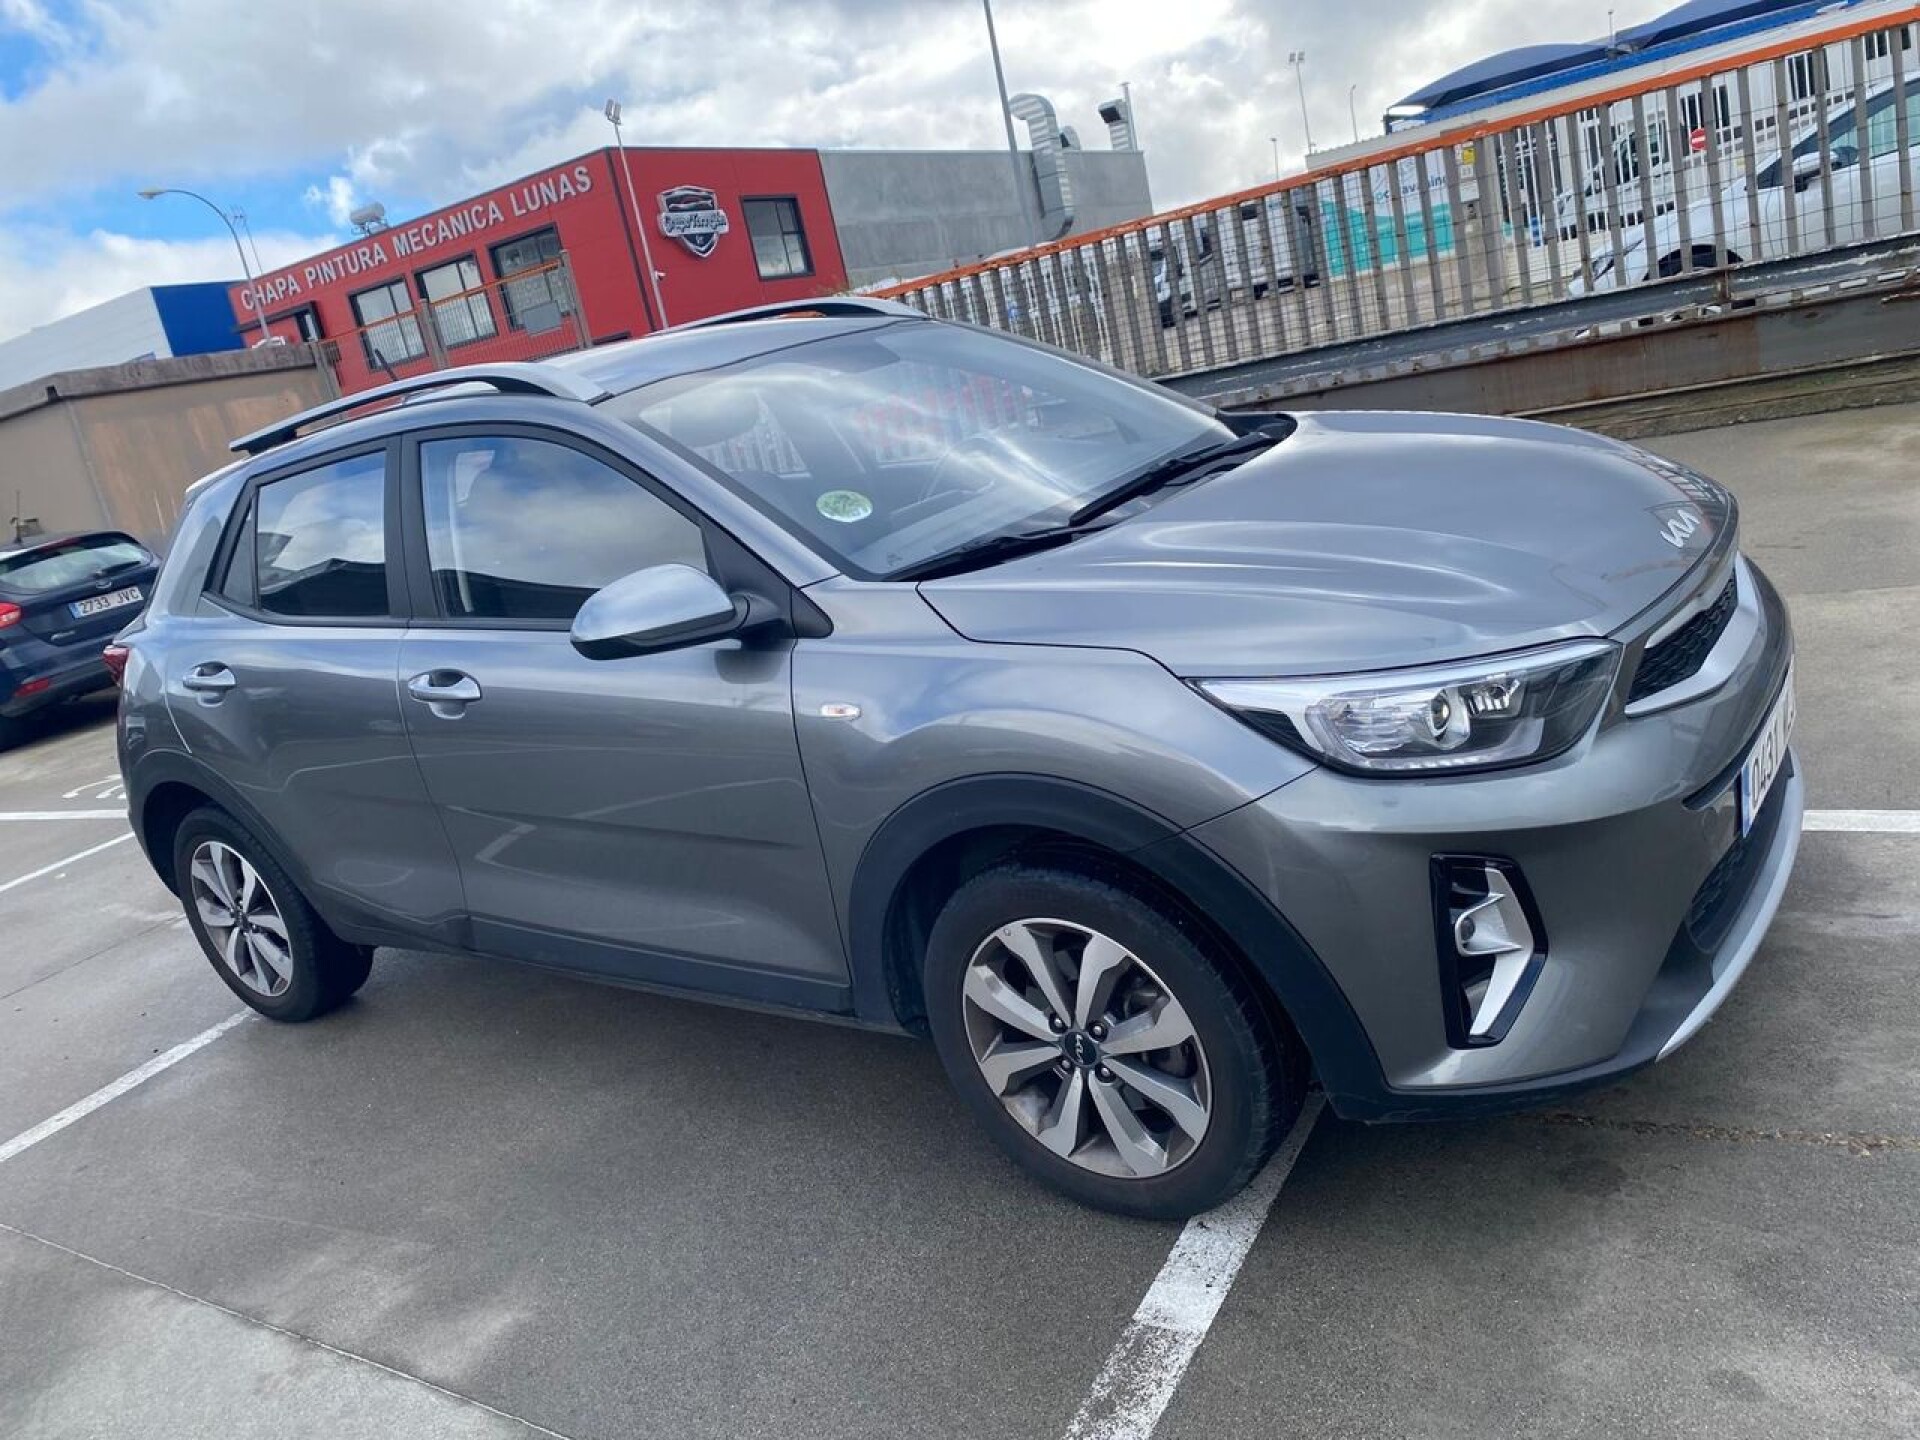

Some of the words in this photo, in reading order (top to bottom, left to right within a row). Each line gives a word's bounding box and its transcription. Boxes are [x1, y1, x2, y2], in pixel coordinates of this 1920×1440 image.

[241, 275, 302, 311] CHAPA
[305, 243, 389, 289] PINTURA
[392, 201, 505, 257] MECANICA
[509, 165, 593, 217] LUNAS
[80, 596, 111, 614] 2733
[117, 588, 139, 604] JVC
[1751, 719, 1778, 810] 0431
